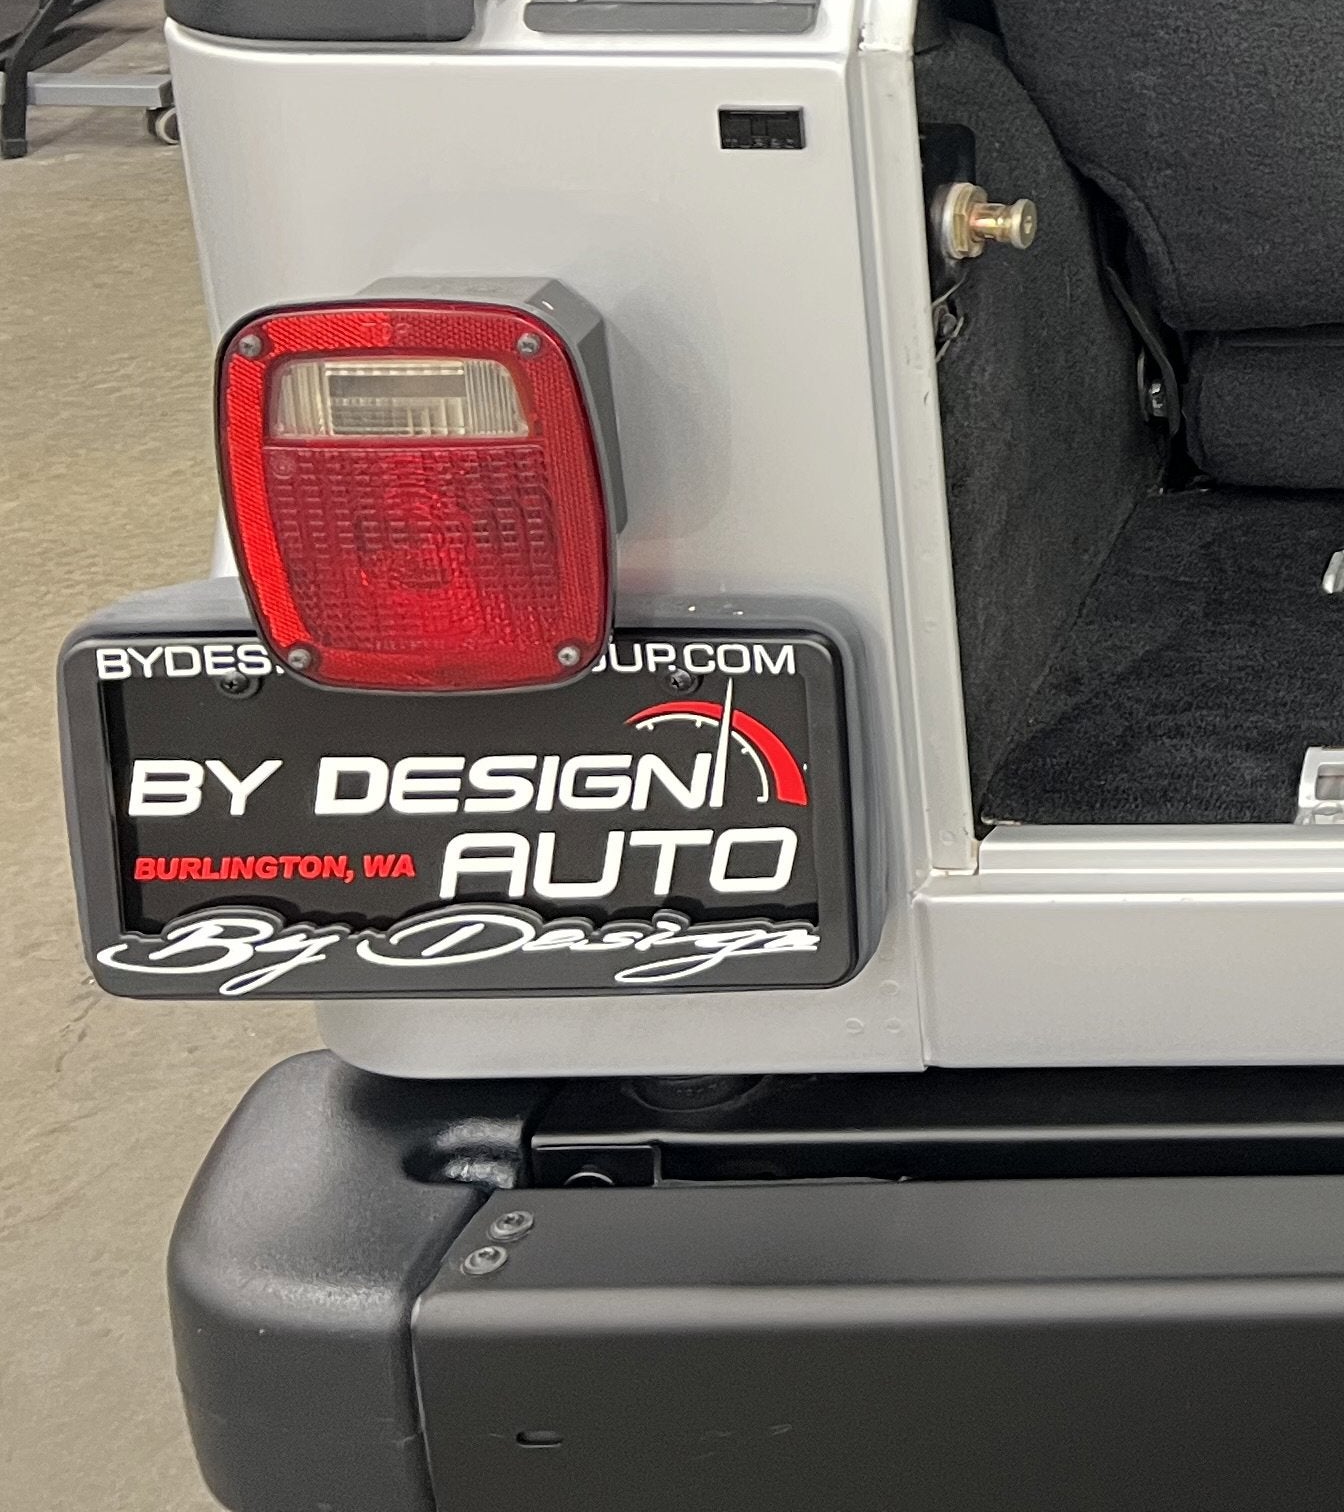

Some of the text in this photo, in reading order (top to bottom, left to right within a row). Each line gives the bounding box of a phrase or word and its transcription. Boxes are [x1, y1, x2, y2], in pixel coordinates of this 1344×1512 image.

[128, 752, 713, 817] BY DESIGN
[134, 853, 416, 884] BURLINGTON, WA
[439, 826, 798, 900] AUTO
[96, 918, 341, 996] By
